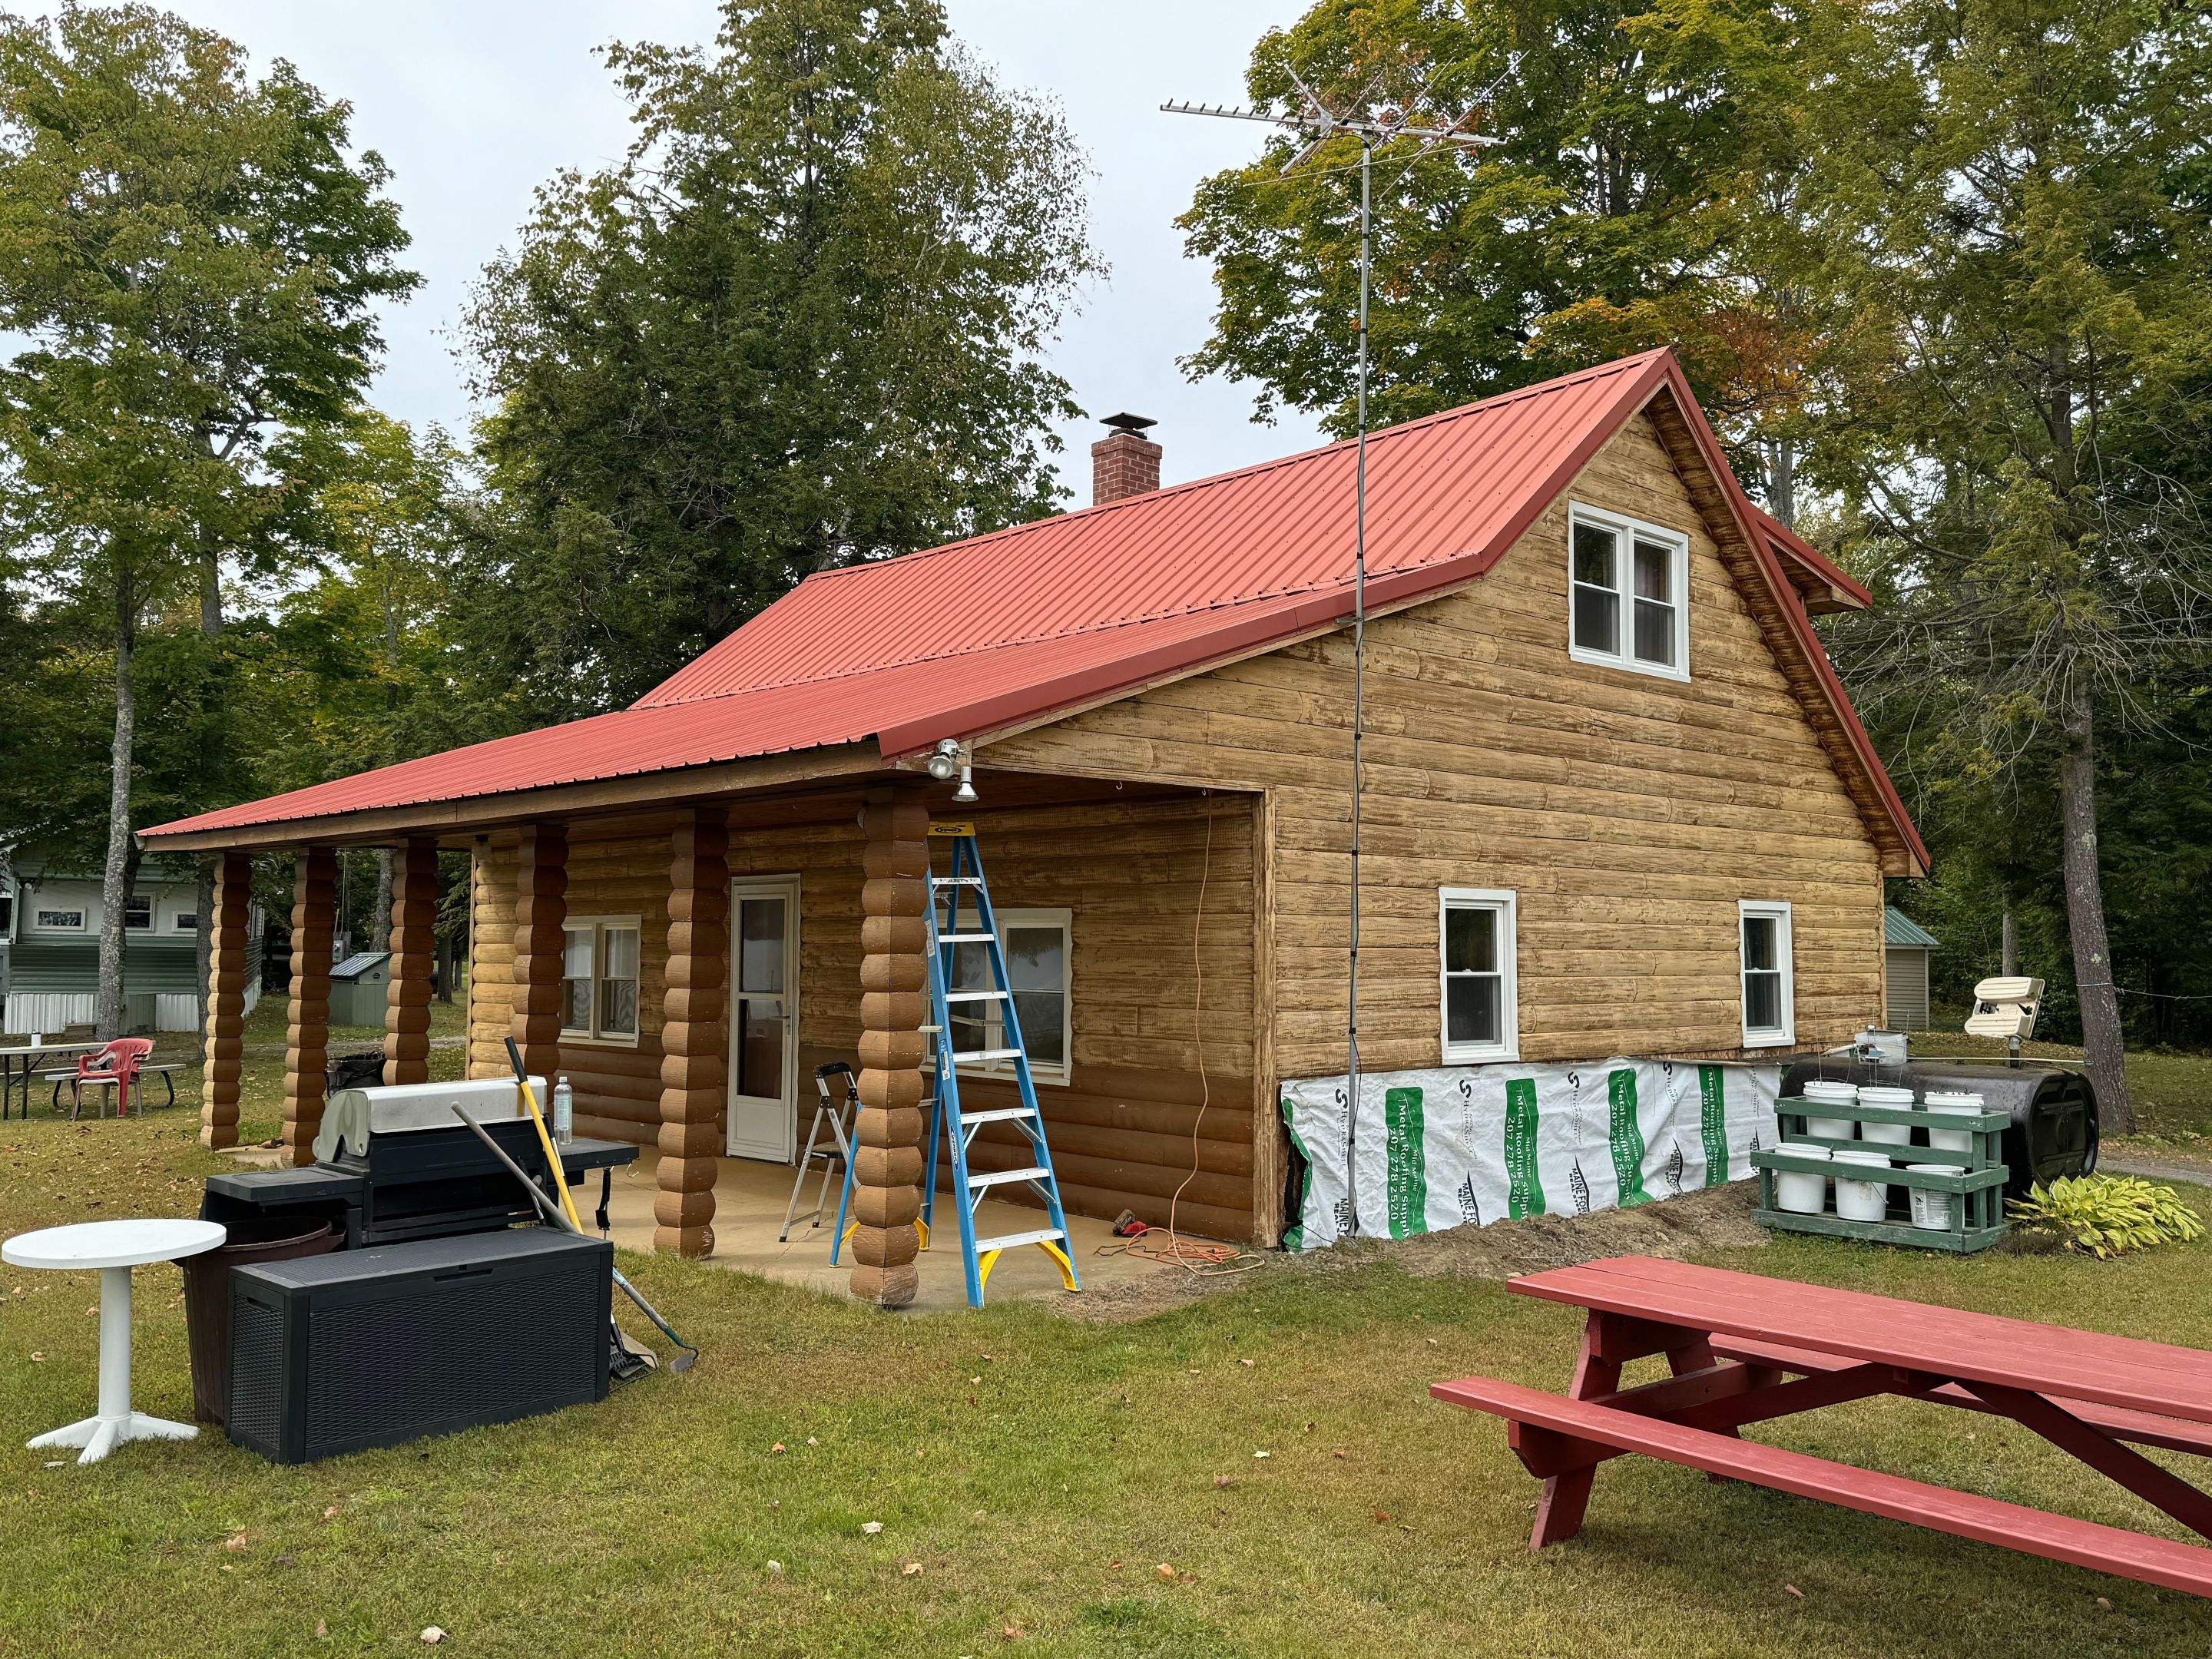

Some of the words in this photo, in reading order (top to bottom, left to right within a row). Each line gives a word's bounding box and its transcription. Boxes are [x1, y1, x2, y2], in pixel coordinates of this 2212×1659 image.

[1516, 1095, 1525, 1128] Metal
[1389, 1128, 1399, 1152] 207
[1506, 1117, 1515, 1140] 207
[1611, 1131, 1620, 1153] 278
[1618, 1118, 1631, 1162] Roofing
[1515, 1131, 1524, 1179] Roofing
[1631, 1137, 1639, 1161] Maine
[1704, 1139, 1714, 1167] 2520
[1390, 1157, 1399, 1182] 278
[1399, 1144, 1410, 1193] Roofing
[1411, 1167, 1419, 1192] Maine
[1571, 1167, 1585, 1194] MAINE
[1614, 1156, 1626, 1187] 2520
[1462, 1182, 1475, 1211] MAINE
[1510, 1171, 1521, 1204] 2520
[1339, 1198, 1349, 1228] MAINE
[1389, 1186, 1399, 1220] 2520
